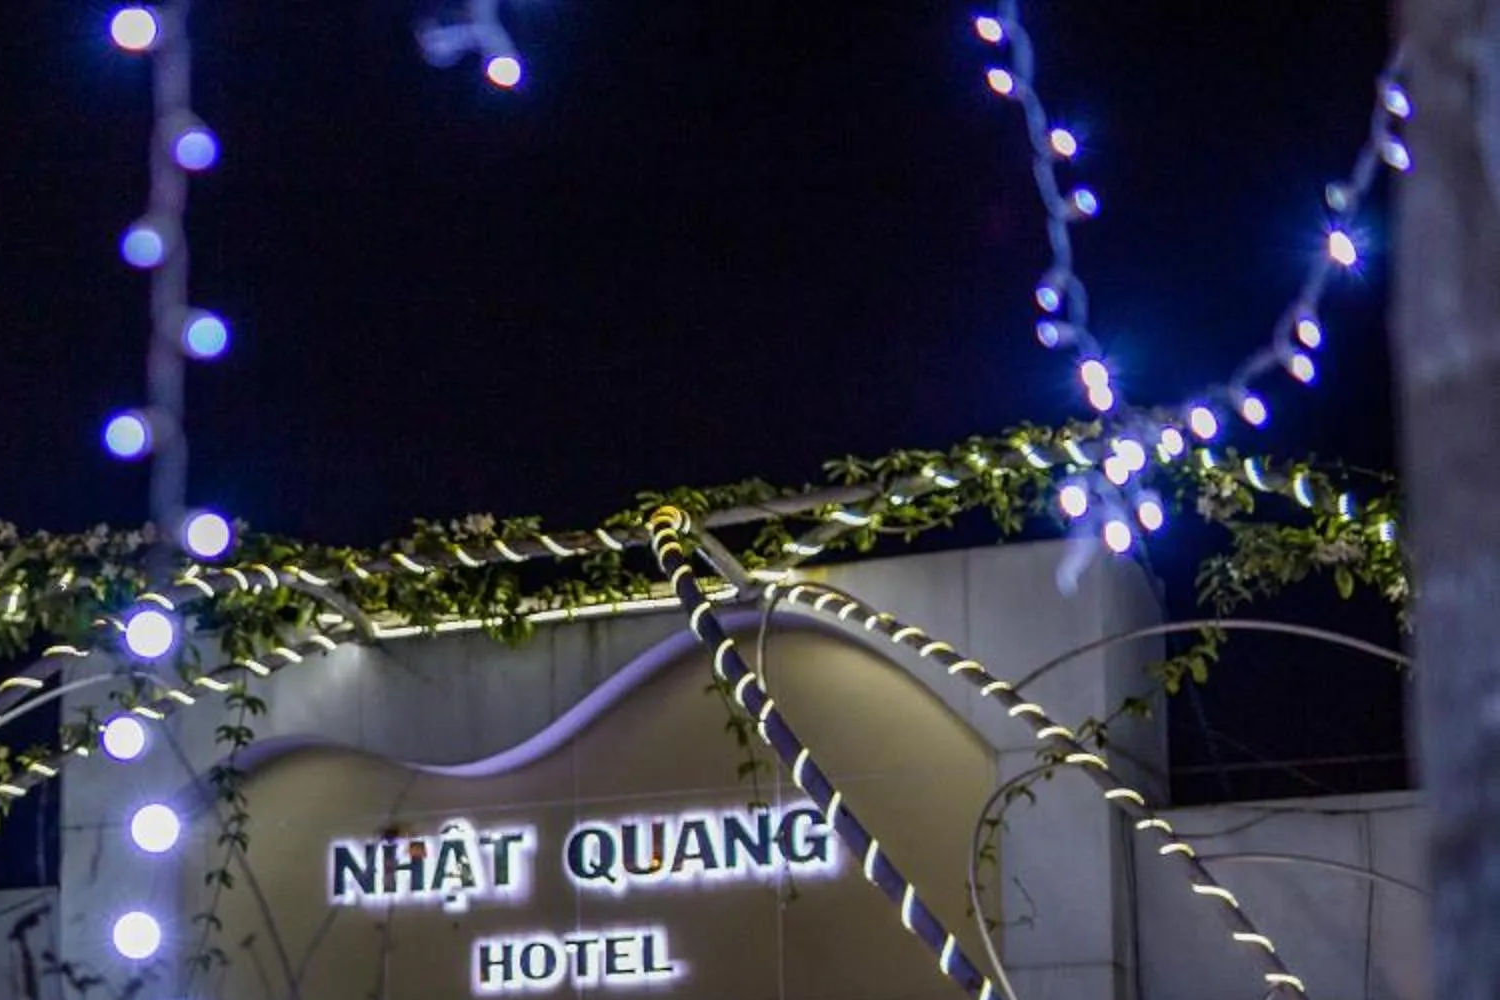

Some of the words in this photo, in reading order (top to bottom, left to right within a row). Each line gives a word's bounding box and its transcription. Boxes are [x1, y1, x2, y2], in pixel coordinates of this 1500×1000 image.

[334, 824, 523, 902] NHẬT
[567, 808, 829, 883] QUANG
[479, 934, 673, 982] HOTEL
